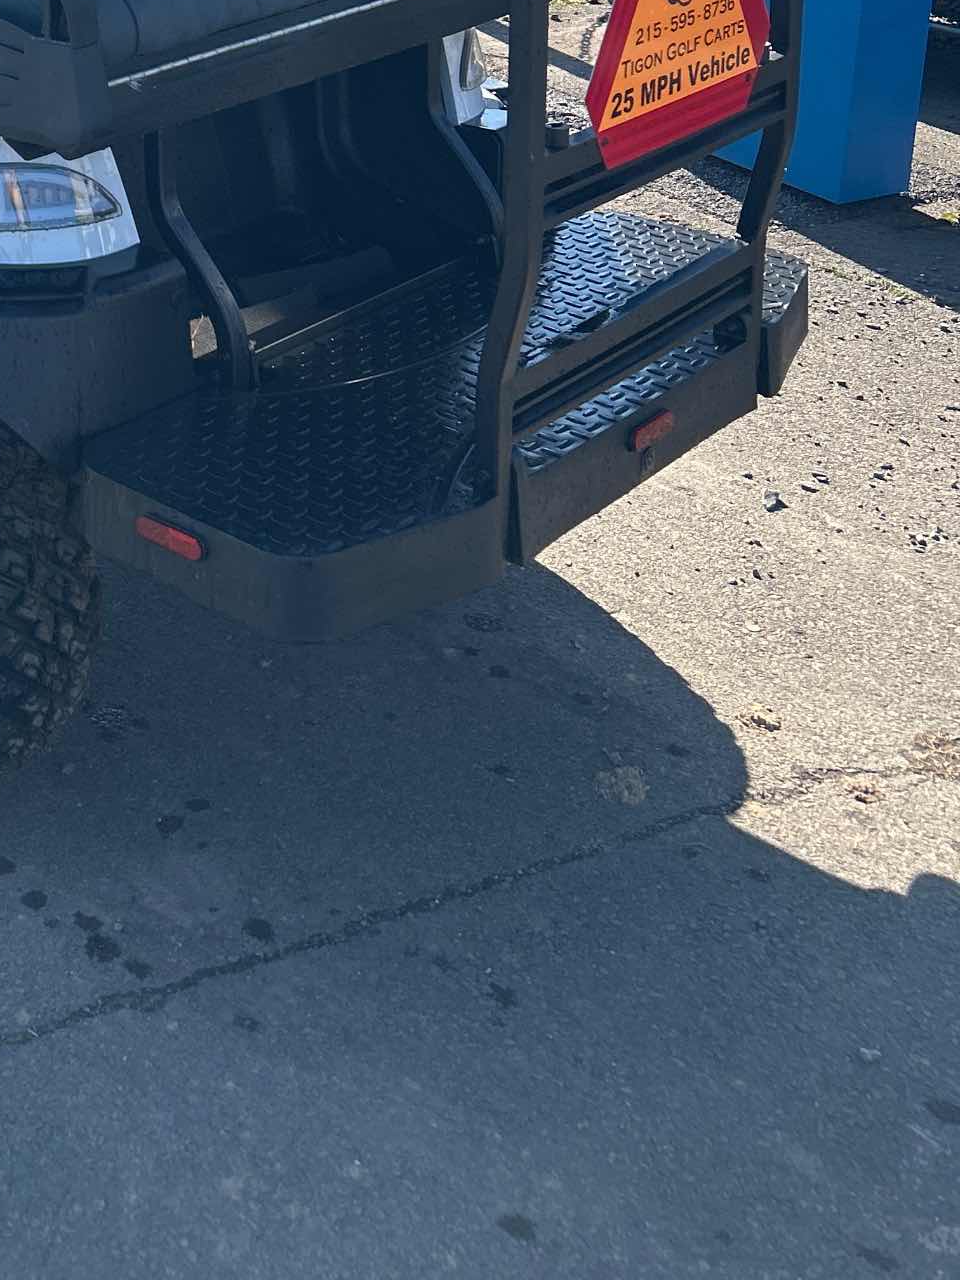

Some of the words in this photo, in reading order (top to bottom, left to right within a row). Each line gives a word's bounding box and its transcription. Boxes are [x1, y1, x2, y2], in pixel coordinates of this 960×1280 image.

[611, 87, 635, 119] 25
[640, 68, 682, 107] MPH
[688, 45, 751, 86] Vehicle
[622, 50, 664, 79] TIGON
[666, 36, 703, 61] GOLF
[704, 19, 745, 47] CARTS
